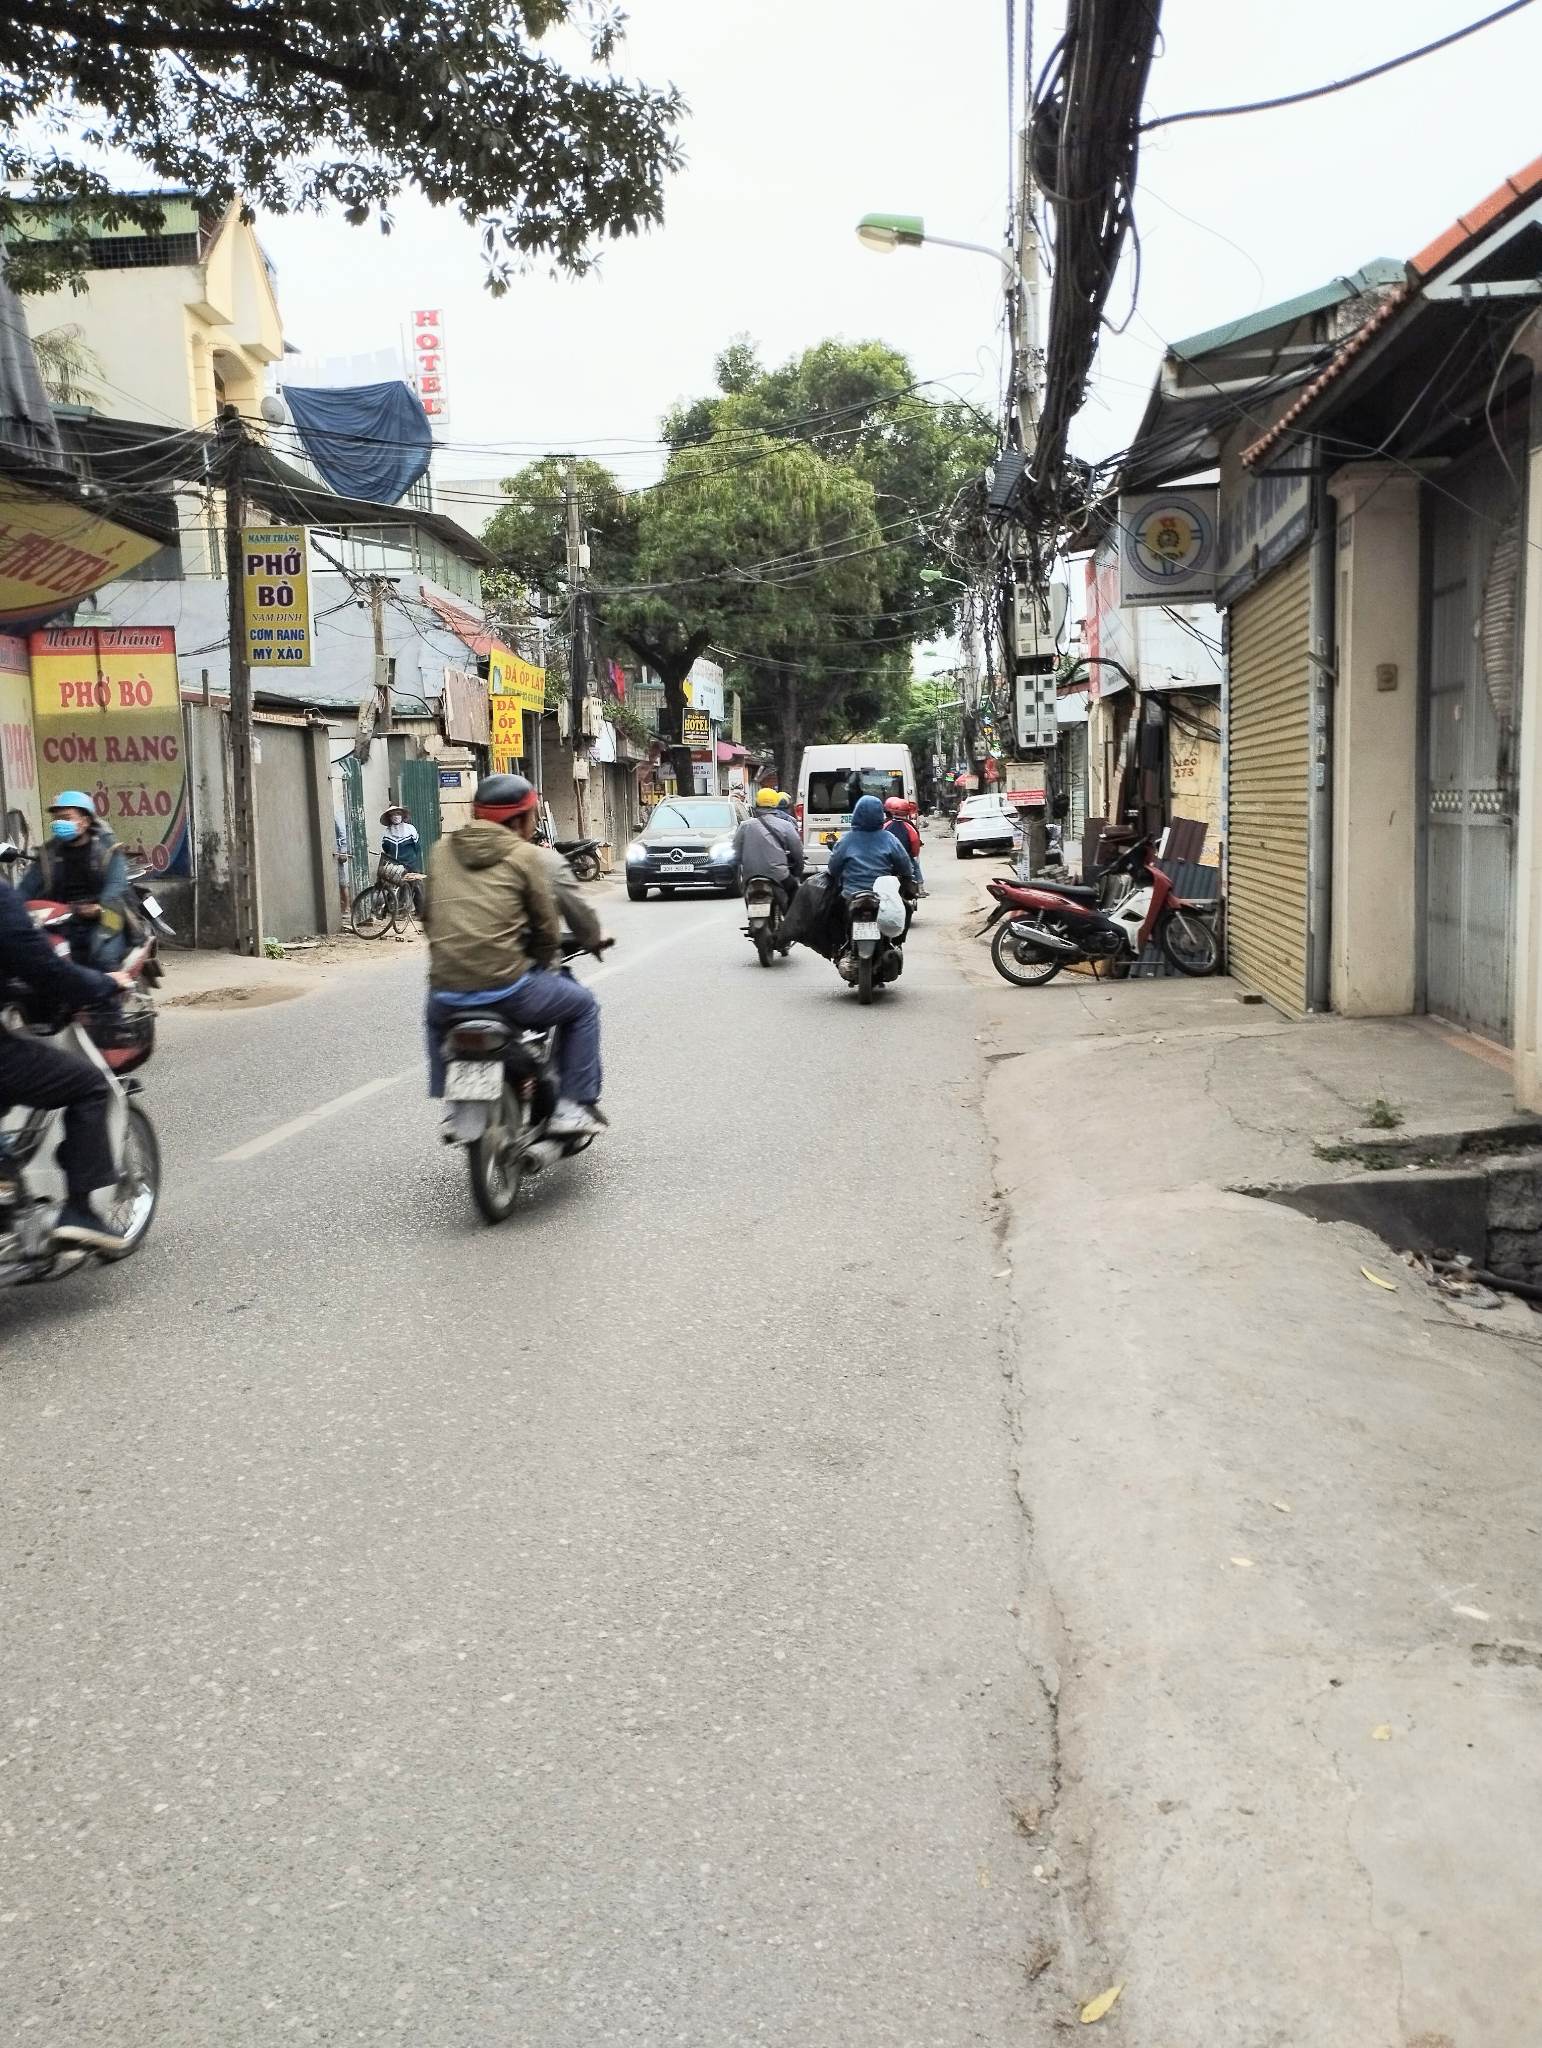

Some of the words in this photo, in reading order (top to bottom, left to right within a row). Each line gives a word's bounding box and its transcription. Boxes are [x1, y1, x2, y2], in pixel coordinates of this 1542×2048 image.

[415, 310, 442, 415] HOTEL
[247, 547, 302, 575] PHỞ
[258, 580, 294, 607] BÒ
[252, 613, 273, 621] NAM
[250, 628, 274, 641] CƠM
[276, 629, 305, 641] RANG
[276, 646, 303, 660] XÀO
[59, 673, 112, 708] PHỞ
[118, 673, 153, 707] BÒ
[496, 697, 516, 711] ĐÁ
[498, 713, 516, 729] ỐP
[684, 719, 709, 730] HOTEL
[495, 730, 521, 745] LÁT
[43, 732, 98, 763] CƠM
[104, 735, 178, 763] RANG
[117, 782, 172, 817] XÀO
